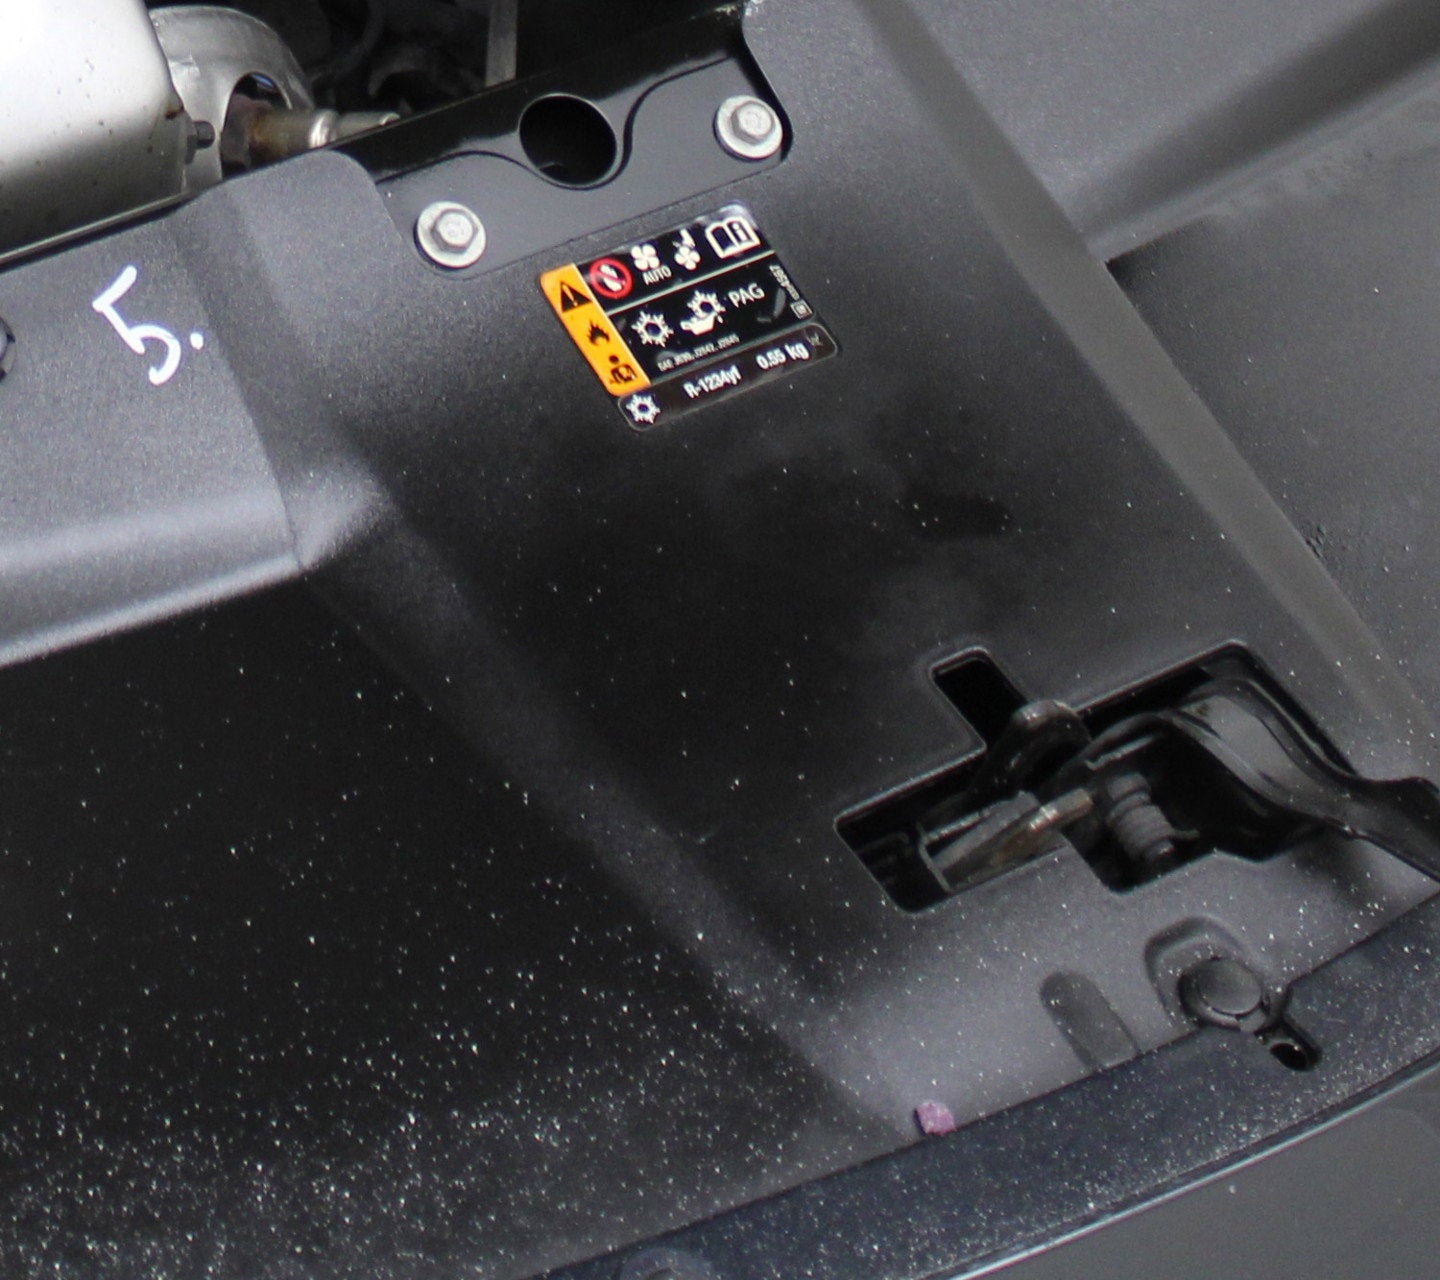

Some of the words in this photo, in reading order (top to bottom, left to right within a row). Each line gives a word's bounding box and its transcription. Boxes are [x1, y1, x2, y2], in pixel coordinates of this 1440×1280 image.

[643, 265, 672, 286] AUTO
[728, 283, 765, 308] PAG
[683, 365, 742, 399] R-1234yf
[756, 347, 786, 370] 0.55
[784, 343, 810, 361] kg
